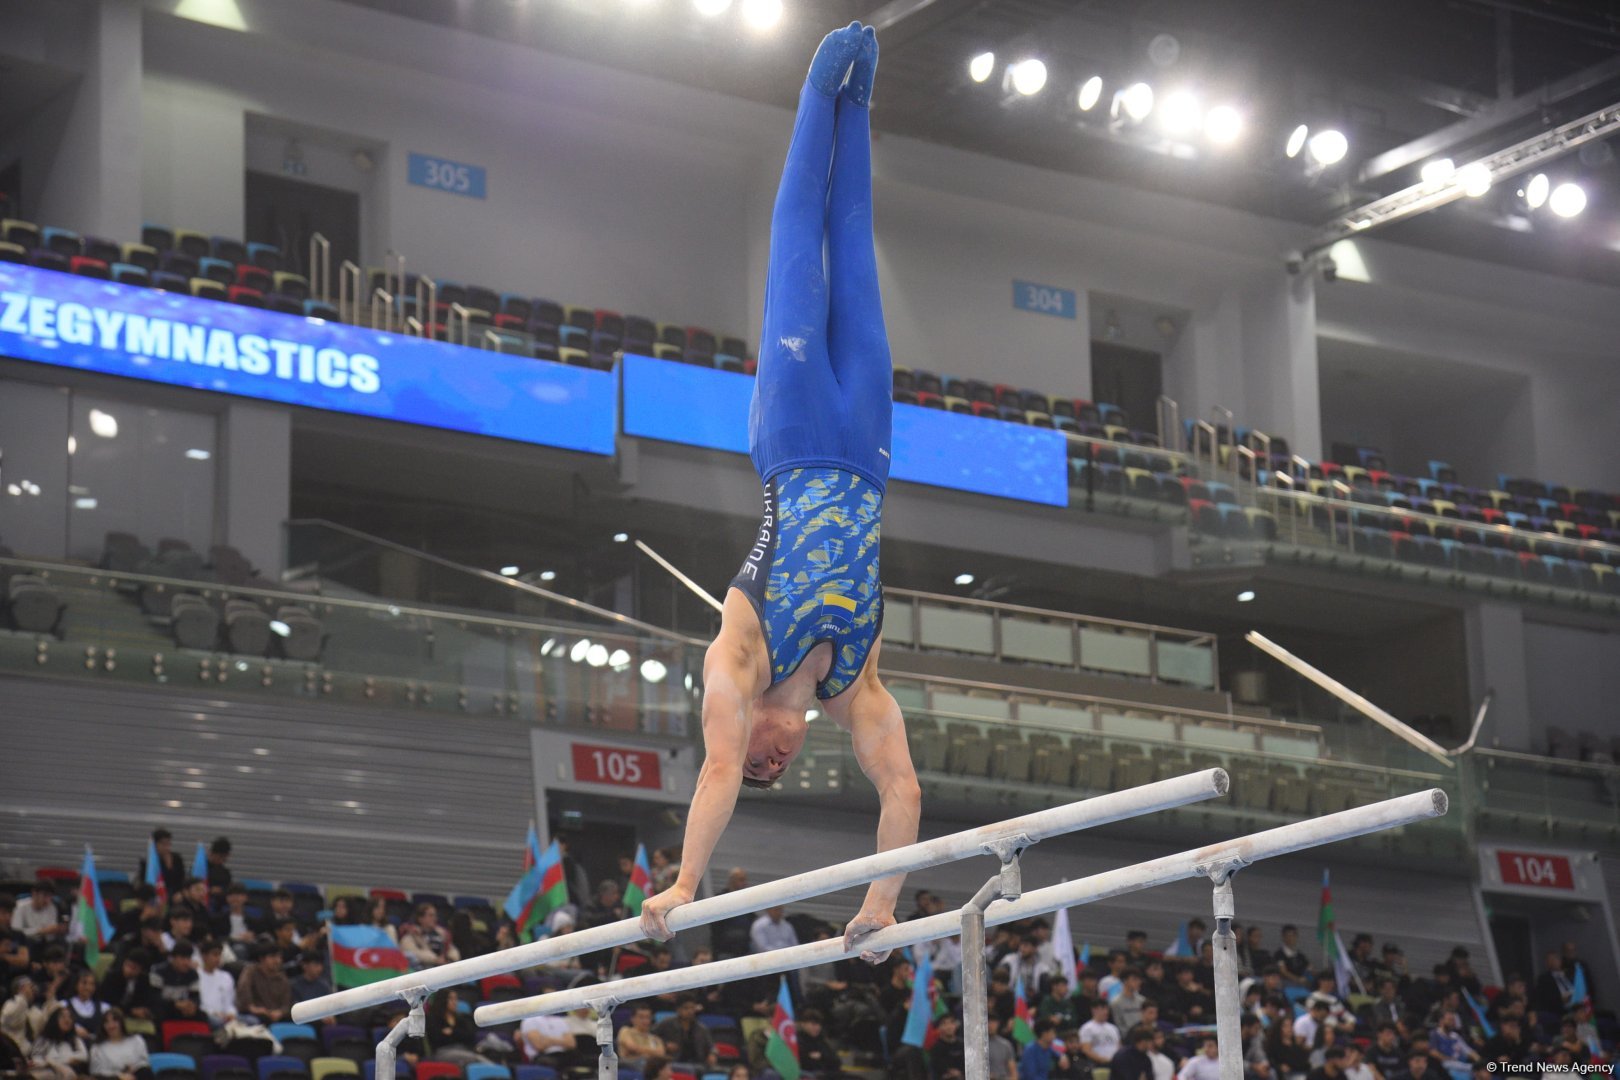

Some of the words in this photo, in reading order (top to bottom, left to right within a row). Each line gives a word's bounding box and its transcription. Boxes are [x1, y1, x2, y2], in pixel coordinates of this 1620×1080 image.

[424, 160, 470, 191] 305
[1026, 285, 1062, 312] 304
[0, 291, 380, 394] ZEGYMNASTICS
[743, 483, 773, 581] UKRAINE
[592, 751, 642, 783] 105
[1514, 857, 1556, 885] 104
